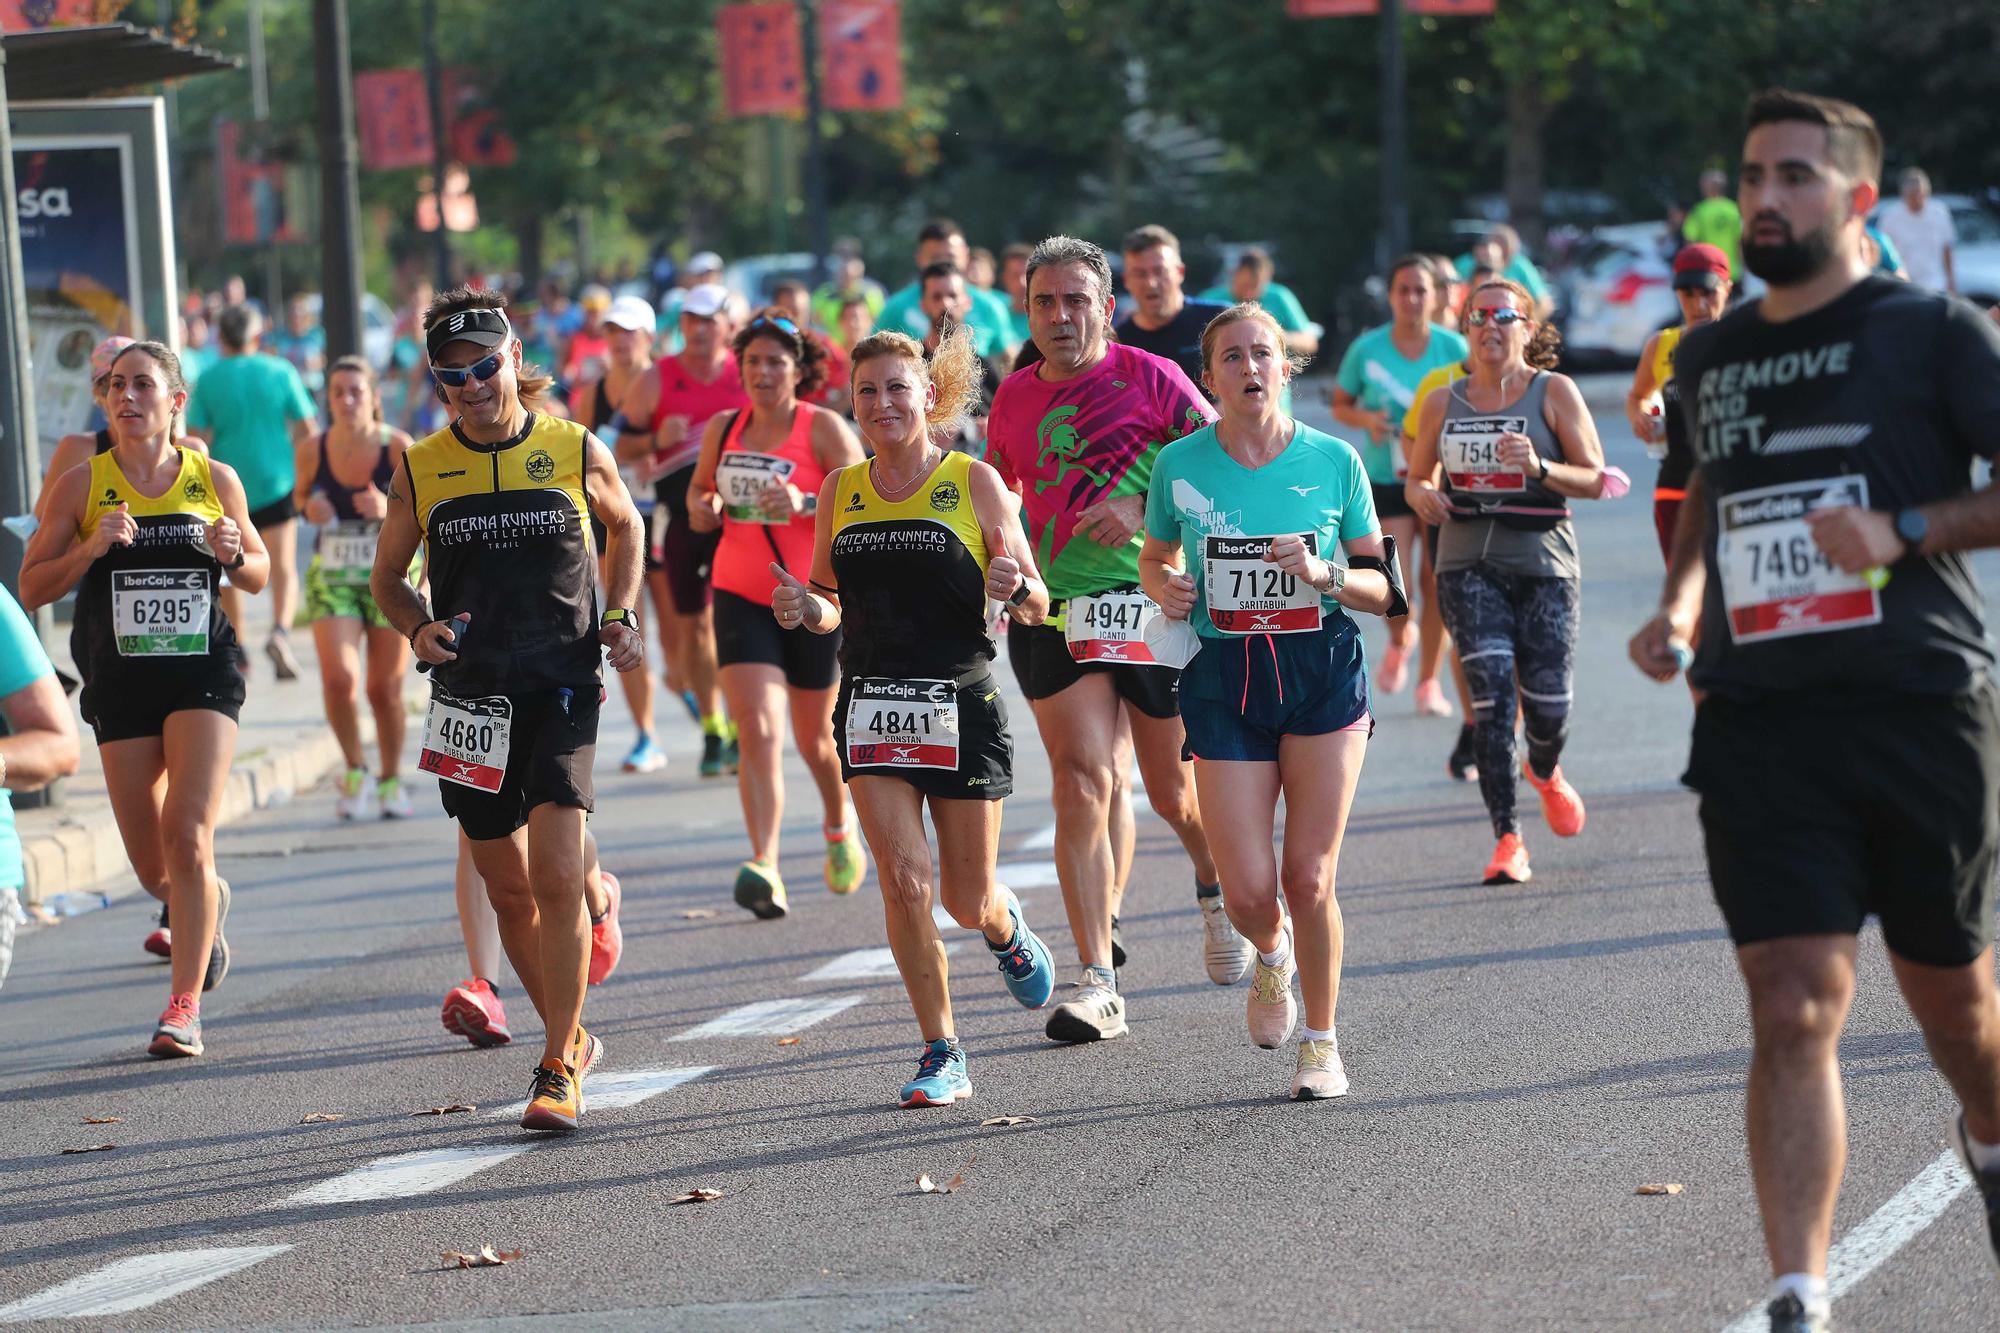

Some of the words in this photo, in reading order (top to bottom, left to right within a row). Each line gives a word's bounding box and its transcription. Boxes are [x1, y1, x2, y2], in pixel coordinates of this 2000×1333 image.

[1699, 342, 1854, 396] REMOVE
[1700, 394, 1748, 425] AND
[1697, 414, 1766, 463] LIFT
[438, 515, 497, 537] PATERNA
[500, 509, 566, 528] RUNNERS
[1200, 511, 1226, 528] RUN
[159, 523, 205, 540] RUNNERS
[440, 533, 472, 546] CLUB
[482, 524, 566, 541] ATLETISMO
[836, 531, 887, 548] PATERNA
[889, 530, 946, 544] RUNNERS
[488, 541, 520, 550] TRAIL
[835, 546, 863, 555] CLUB
[870, 542, 945, 553] ATLETISMO
[124, 575, 175, 588] iberCaja
[1229, 569, 1296, 599] 7120
[133, 599, 191, 624] 6295
[1239, 600, 1286, 610] SARITABUH
[1084, 602, 1143, 630] 4947
[1216, 610, 1234, 625] 03
[148, 626, 177, 634] MARINA
[863, 682, 916, 698] iberCaja
[868, 710, 931, 735] 4841
[439, 717, 493, 754] 4680
[884, 735, 922, 744] CONSTAN
[427, 751, 443, 768] 02
[443, 745, 464, 760] RUBEN
[858, 744, 876, 760] 02
